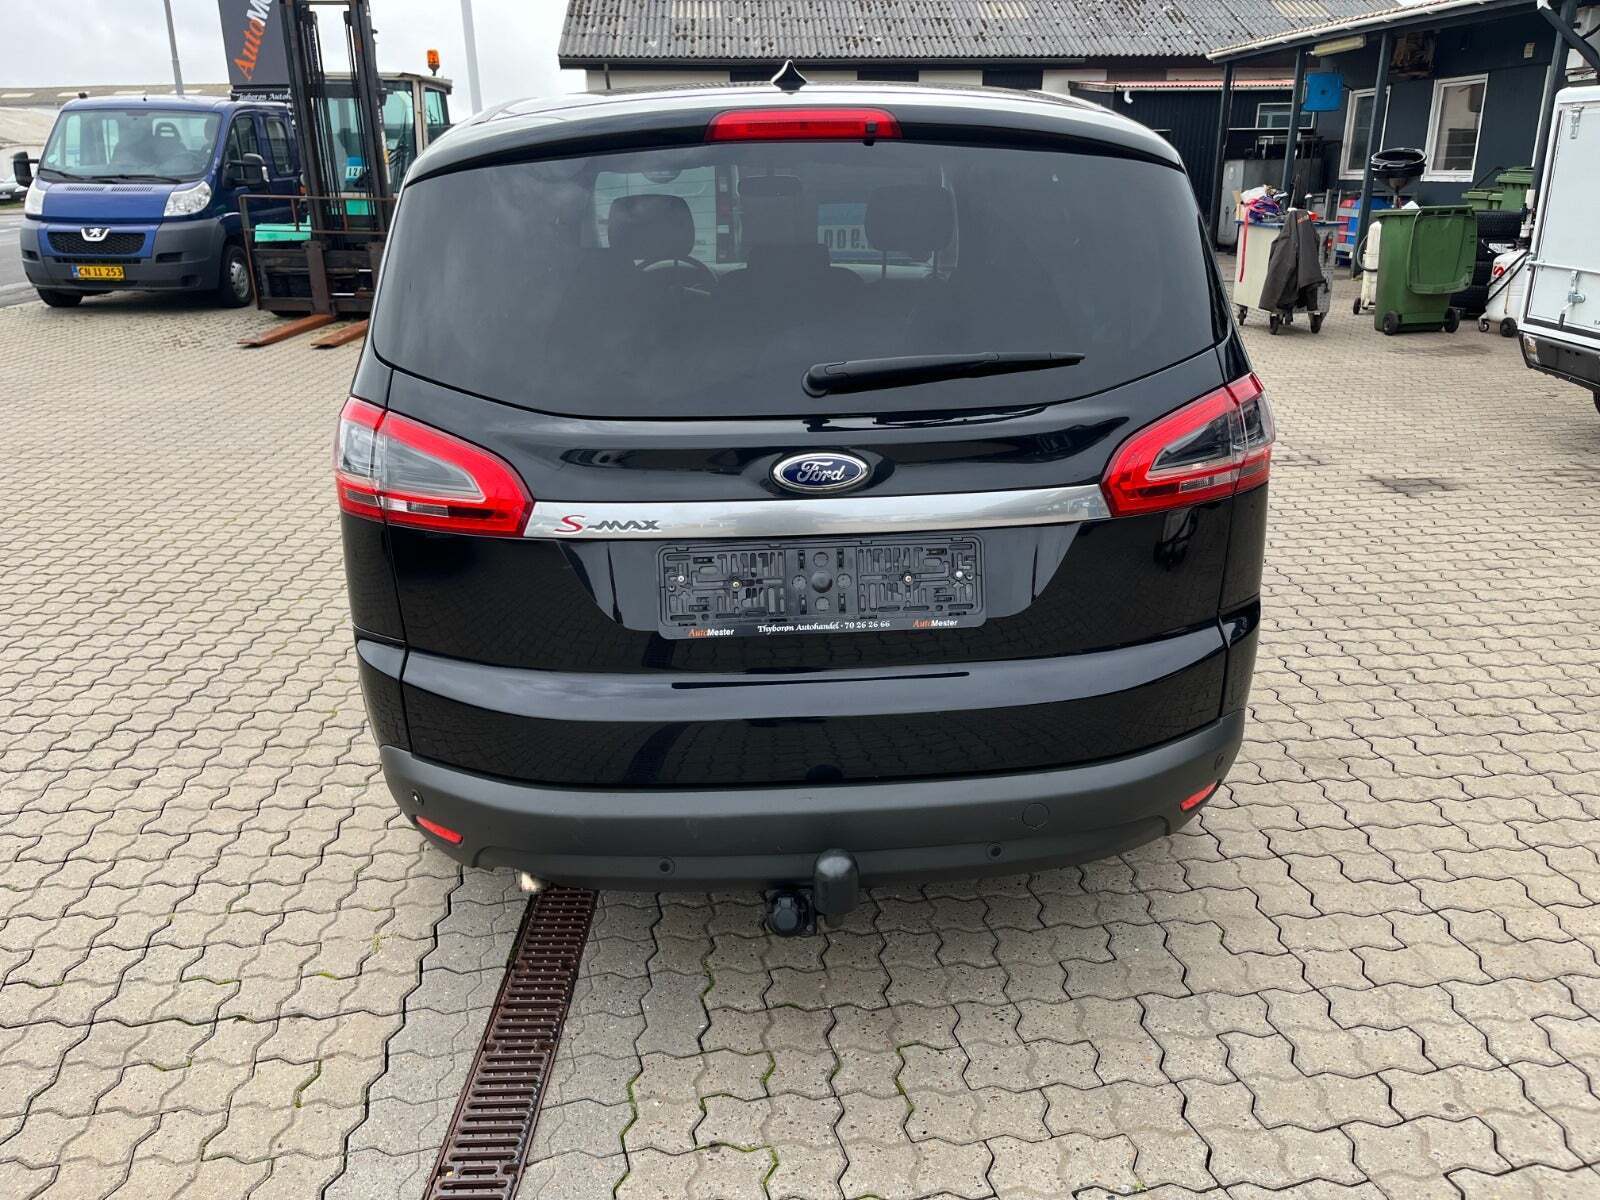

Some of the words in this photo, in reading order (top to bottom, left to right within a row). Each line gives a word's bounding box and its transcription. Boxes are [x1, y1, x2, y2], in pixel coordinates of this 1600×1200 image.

[232, 0, 272, 80] AutoM
[79, 267, 91, 276] CN
[104, 267, 122, 276] 253
[797, 461, 845, 481] Ford
[554, 514, 661, 533] S-MAX
[757, 624, 795, 635] Thyborøn
[796, 620, 839, 632] Autohandel
[844, 621, 855, 630] 70
[856, 621, 866, 629] 26
[868, 620, 879, 629] 26
[880, 620, 891, 628] 66
[912, 619, 958, 629] AutoMester
[688, 628, 735, 638] AutoMester
